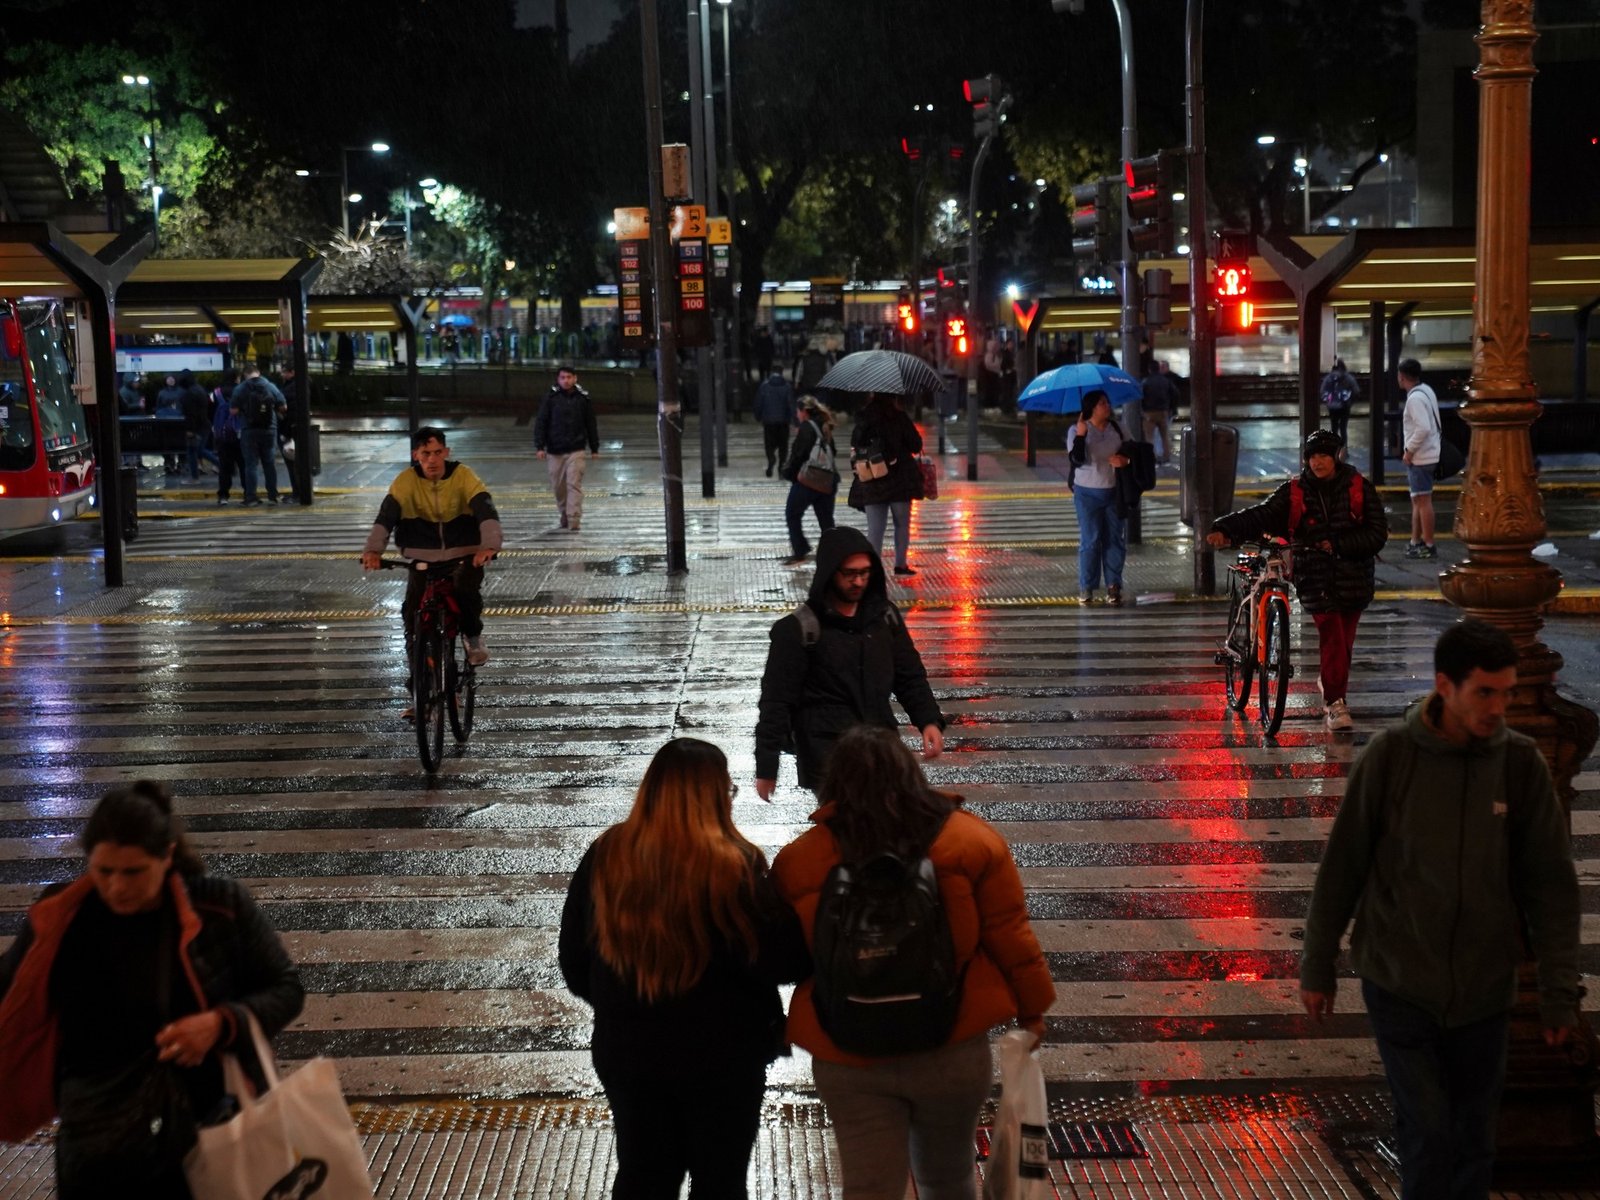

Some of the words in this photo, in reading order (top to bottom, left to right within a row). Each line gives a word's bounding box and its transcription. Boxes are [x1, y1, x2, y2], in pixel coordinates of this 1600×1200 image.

[685, 247, 697, 256] 51
[684, 264, 701, 273] 168
[687, 282, 699, 290] 98
[685, 299, 703, 308] 100
